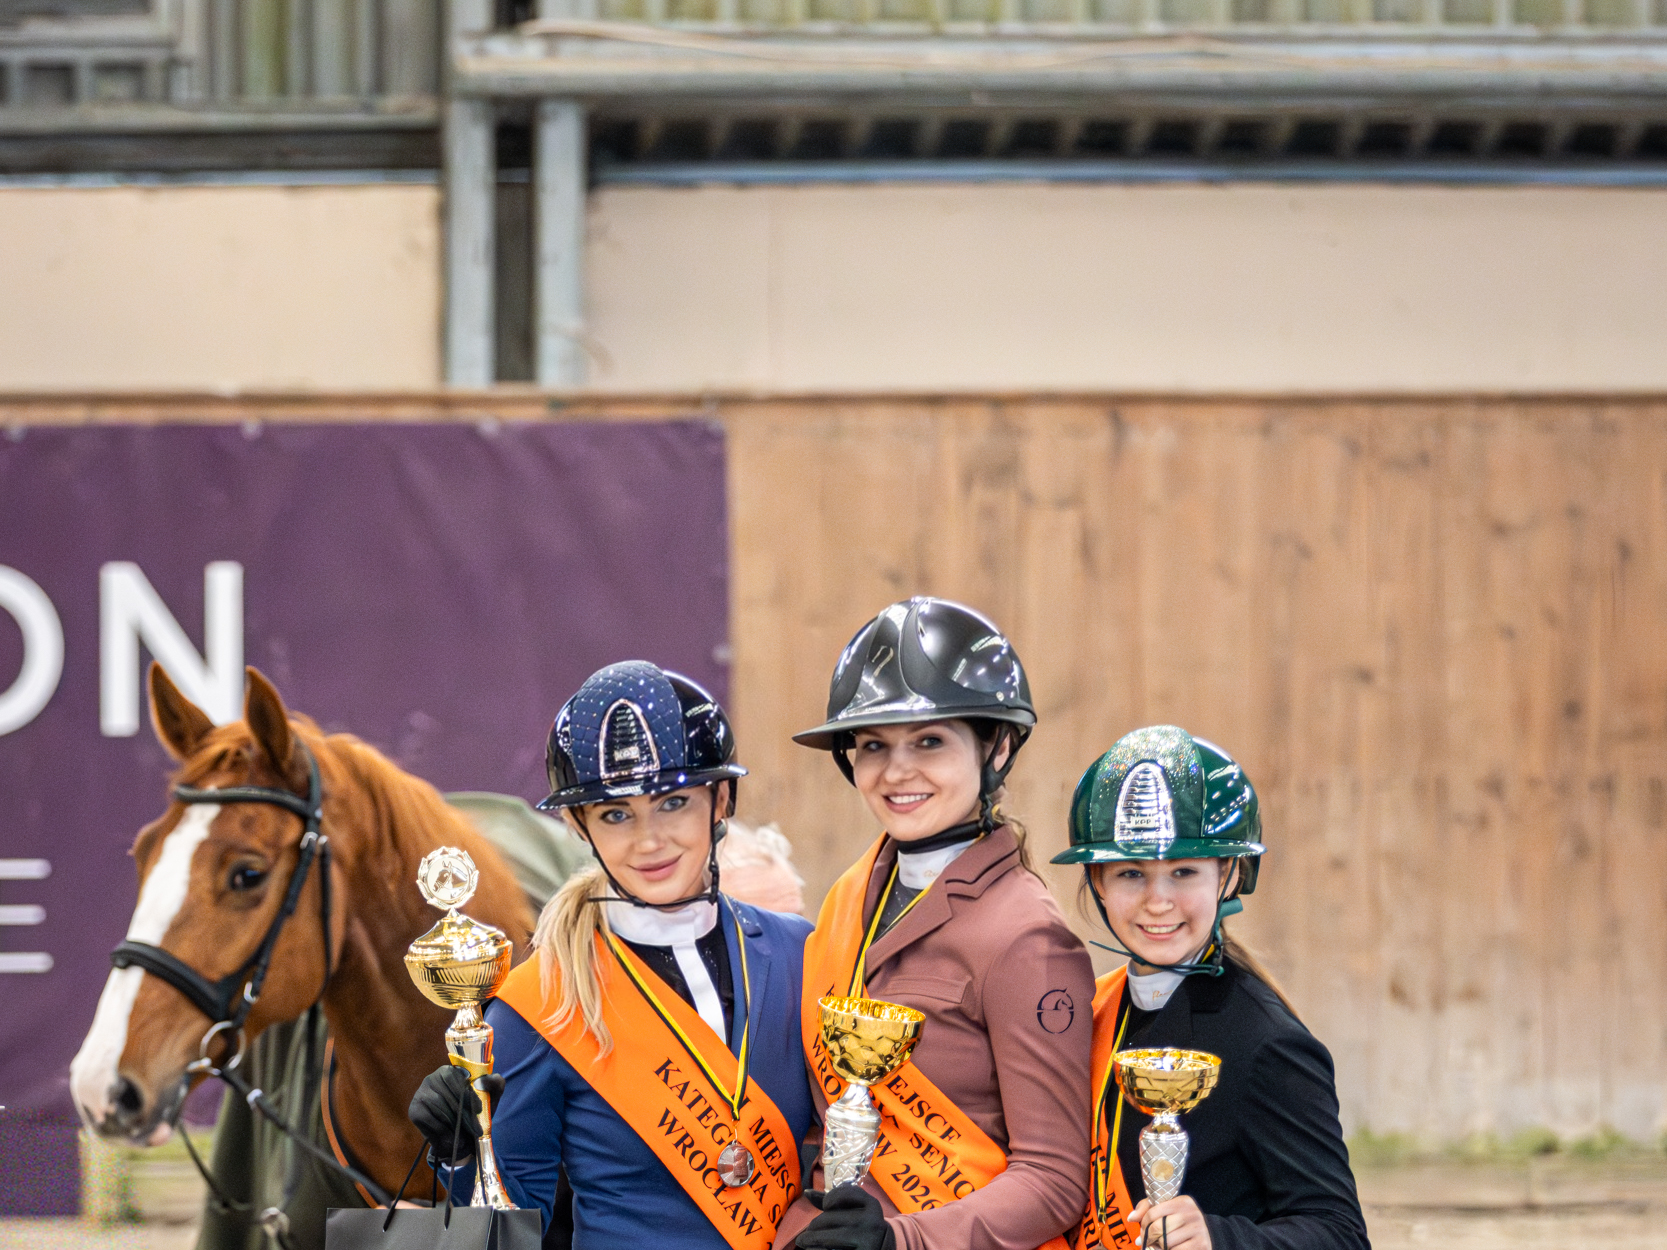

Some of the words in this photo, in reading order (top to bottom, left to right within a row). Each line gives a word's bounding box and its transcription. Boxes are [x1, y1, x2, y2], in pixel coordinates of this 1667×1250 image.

[654, 1057, 768, 1204] KATEGIA
[887, 1074, 961, 1145] EJSCE
[749, 1116, 797, 1203] MIEJSC
[909, 1132, 976, 1200] SENIO
